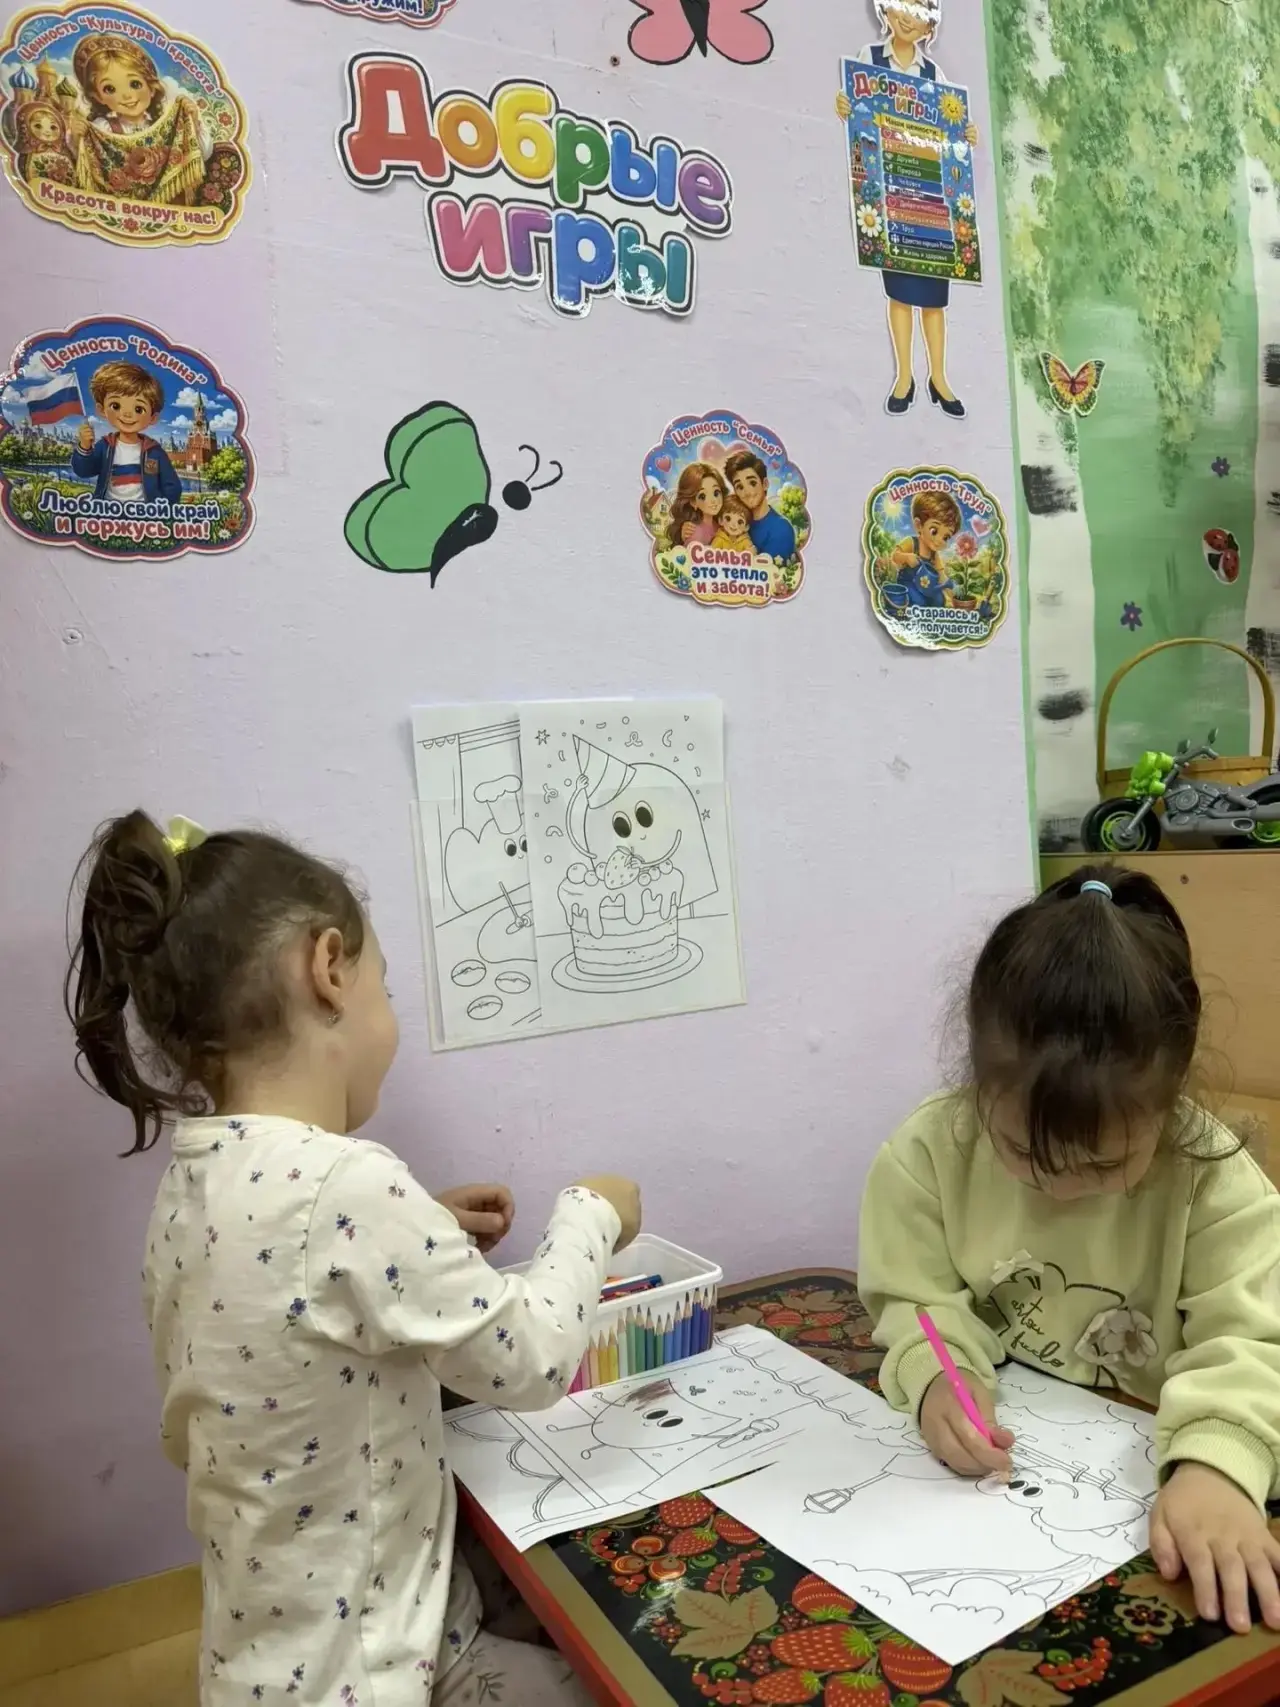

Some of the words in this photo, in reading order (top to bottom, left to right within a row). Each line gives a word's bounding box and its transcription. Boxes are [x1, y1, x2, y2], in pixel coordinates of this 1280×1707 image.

[18, 20, 78, 61] Ценность
[157, 37, 168, 49] и
[854, 72, 918, 99] Добрые
[345, 58, 728, 227] Добрые
[40, 182, 116, 212] Красота
[122, 203, 181, 224] вокруг
[184, 210, 217, 225] нас!
[435, 199, 688, 306] игры
[41, 336, 127, 371] Ценность
[672, 421, 729, 446] Ценность
[889, 479, 950, 503] Ценность
[40, 490, 123, 516] Люблю
[126, 499, 169, 518] свой
[173, 501, 219, 520] край
[56, 518, 71, 533] и
[76, 518, 169, 540] горжусь
[174, 521, 210, 538] им!
[691, 545, 752, 564] Семья
[691, 566, 718, 578] это
[722, 567, 768, 581] тепло
[697, 582, 706, 593] и
[711, 580, 770, 596] забота!
[970, 611, 978, 621] и
